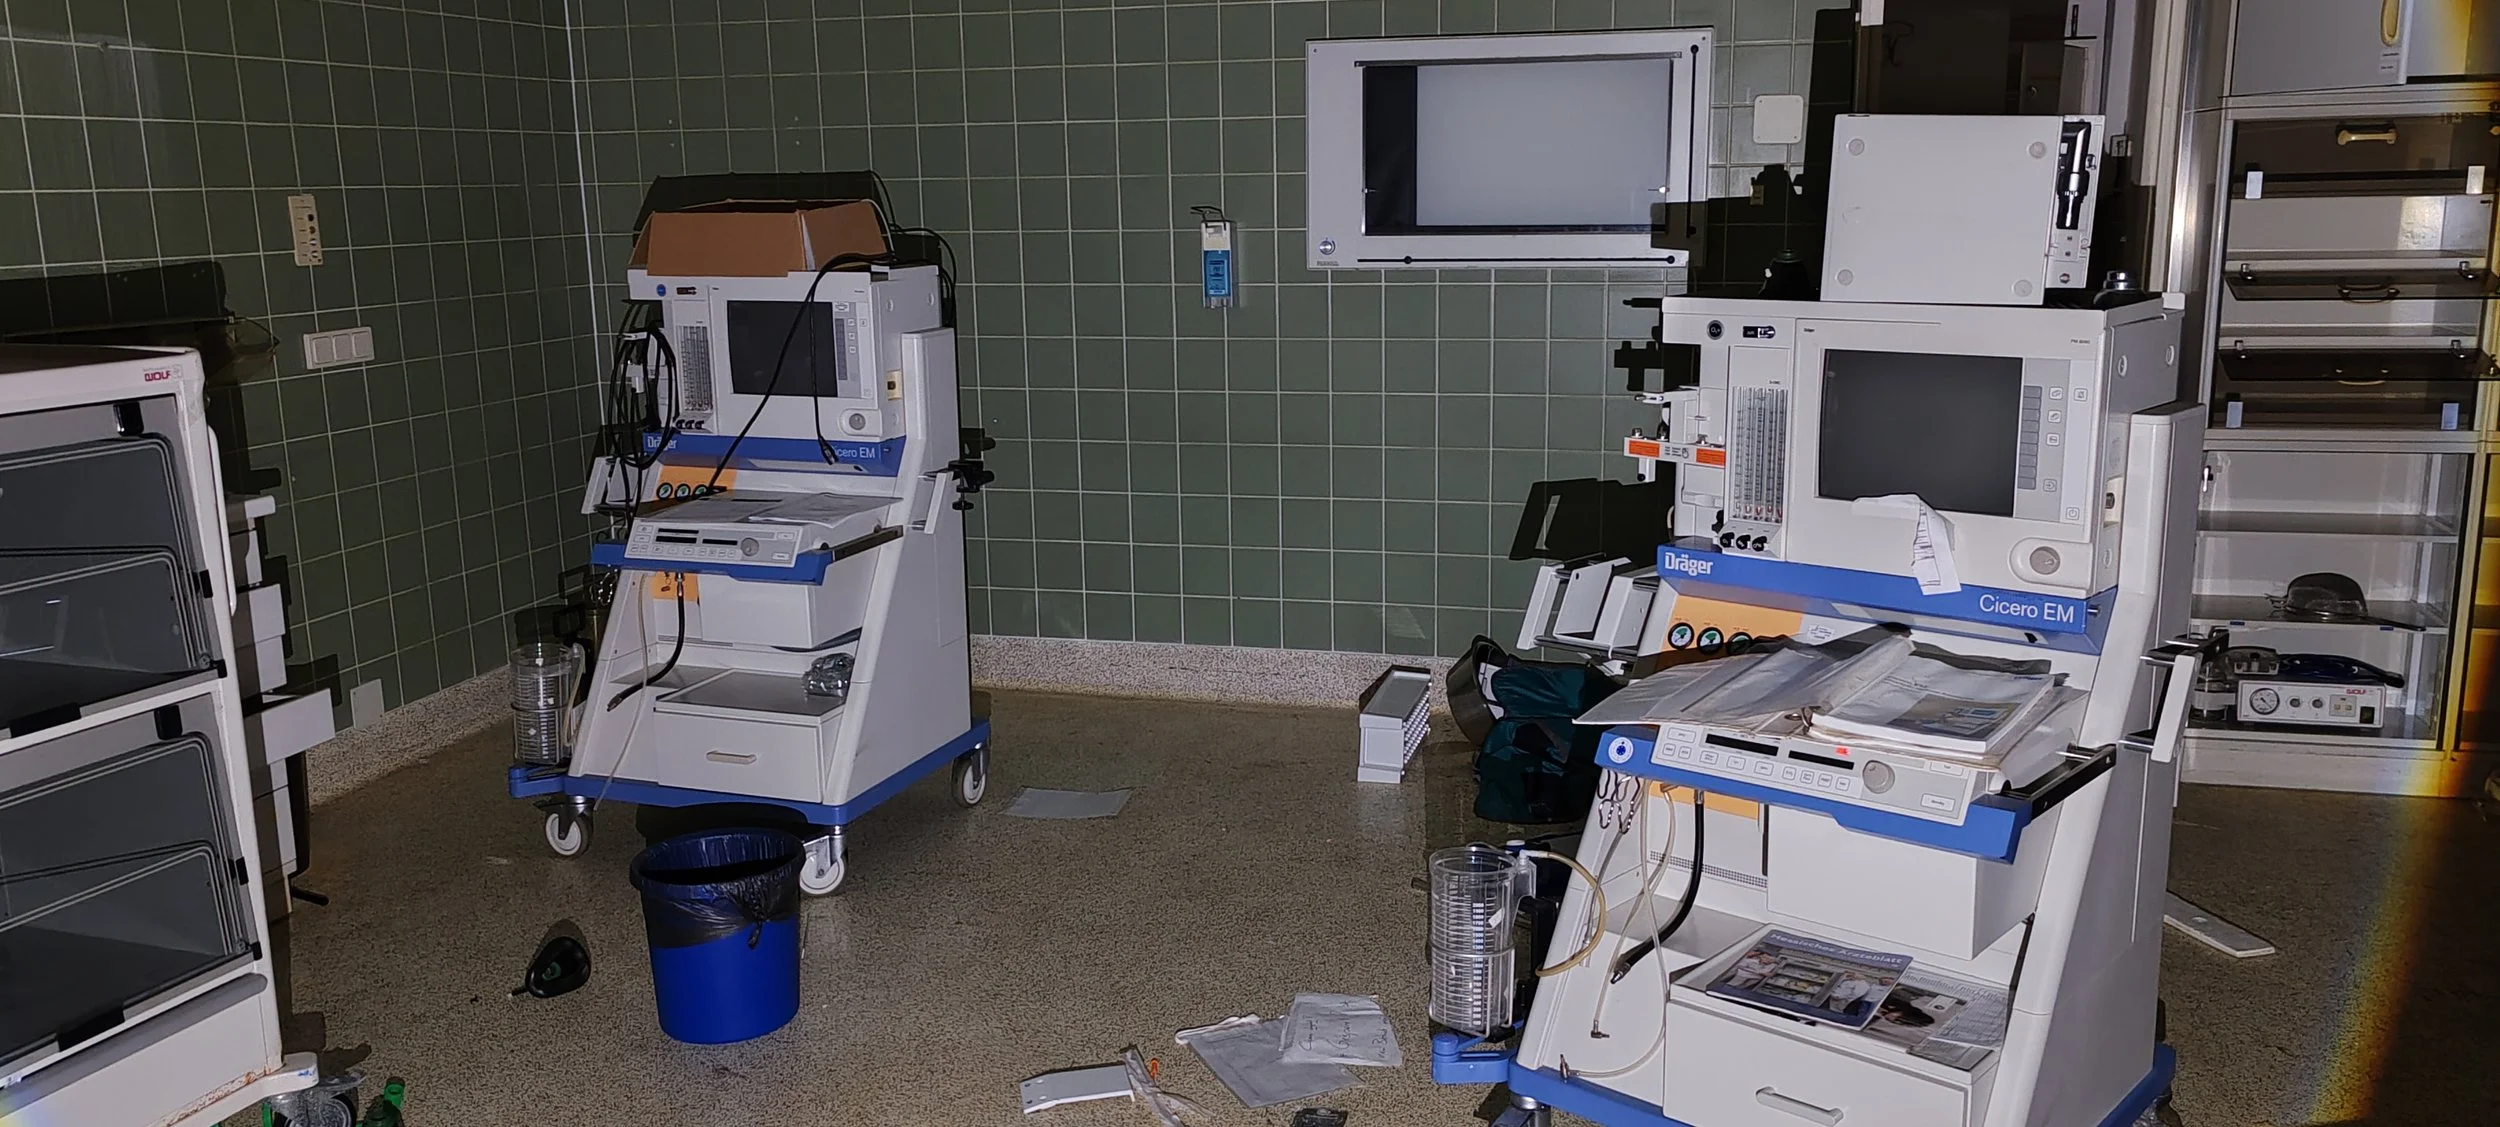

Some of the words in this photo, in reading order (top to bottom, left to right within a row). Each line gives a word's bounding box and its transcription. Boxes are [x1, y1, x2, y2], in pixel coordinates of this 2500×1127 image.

[860, 447, 875, 459] EM
[1665, 552, 1714, 576] Dräger
[1980, 594, 2038, 618] Cicero
[2043, 602, 2074, 623] EM
